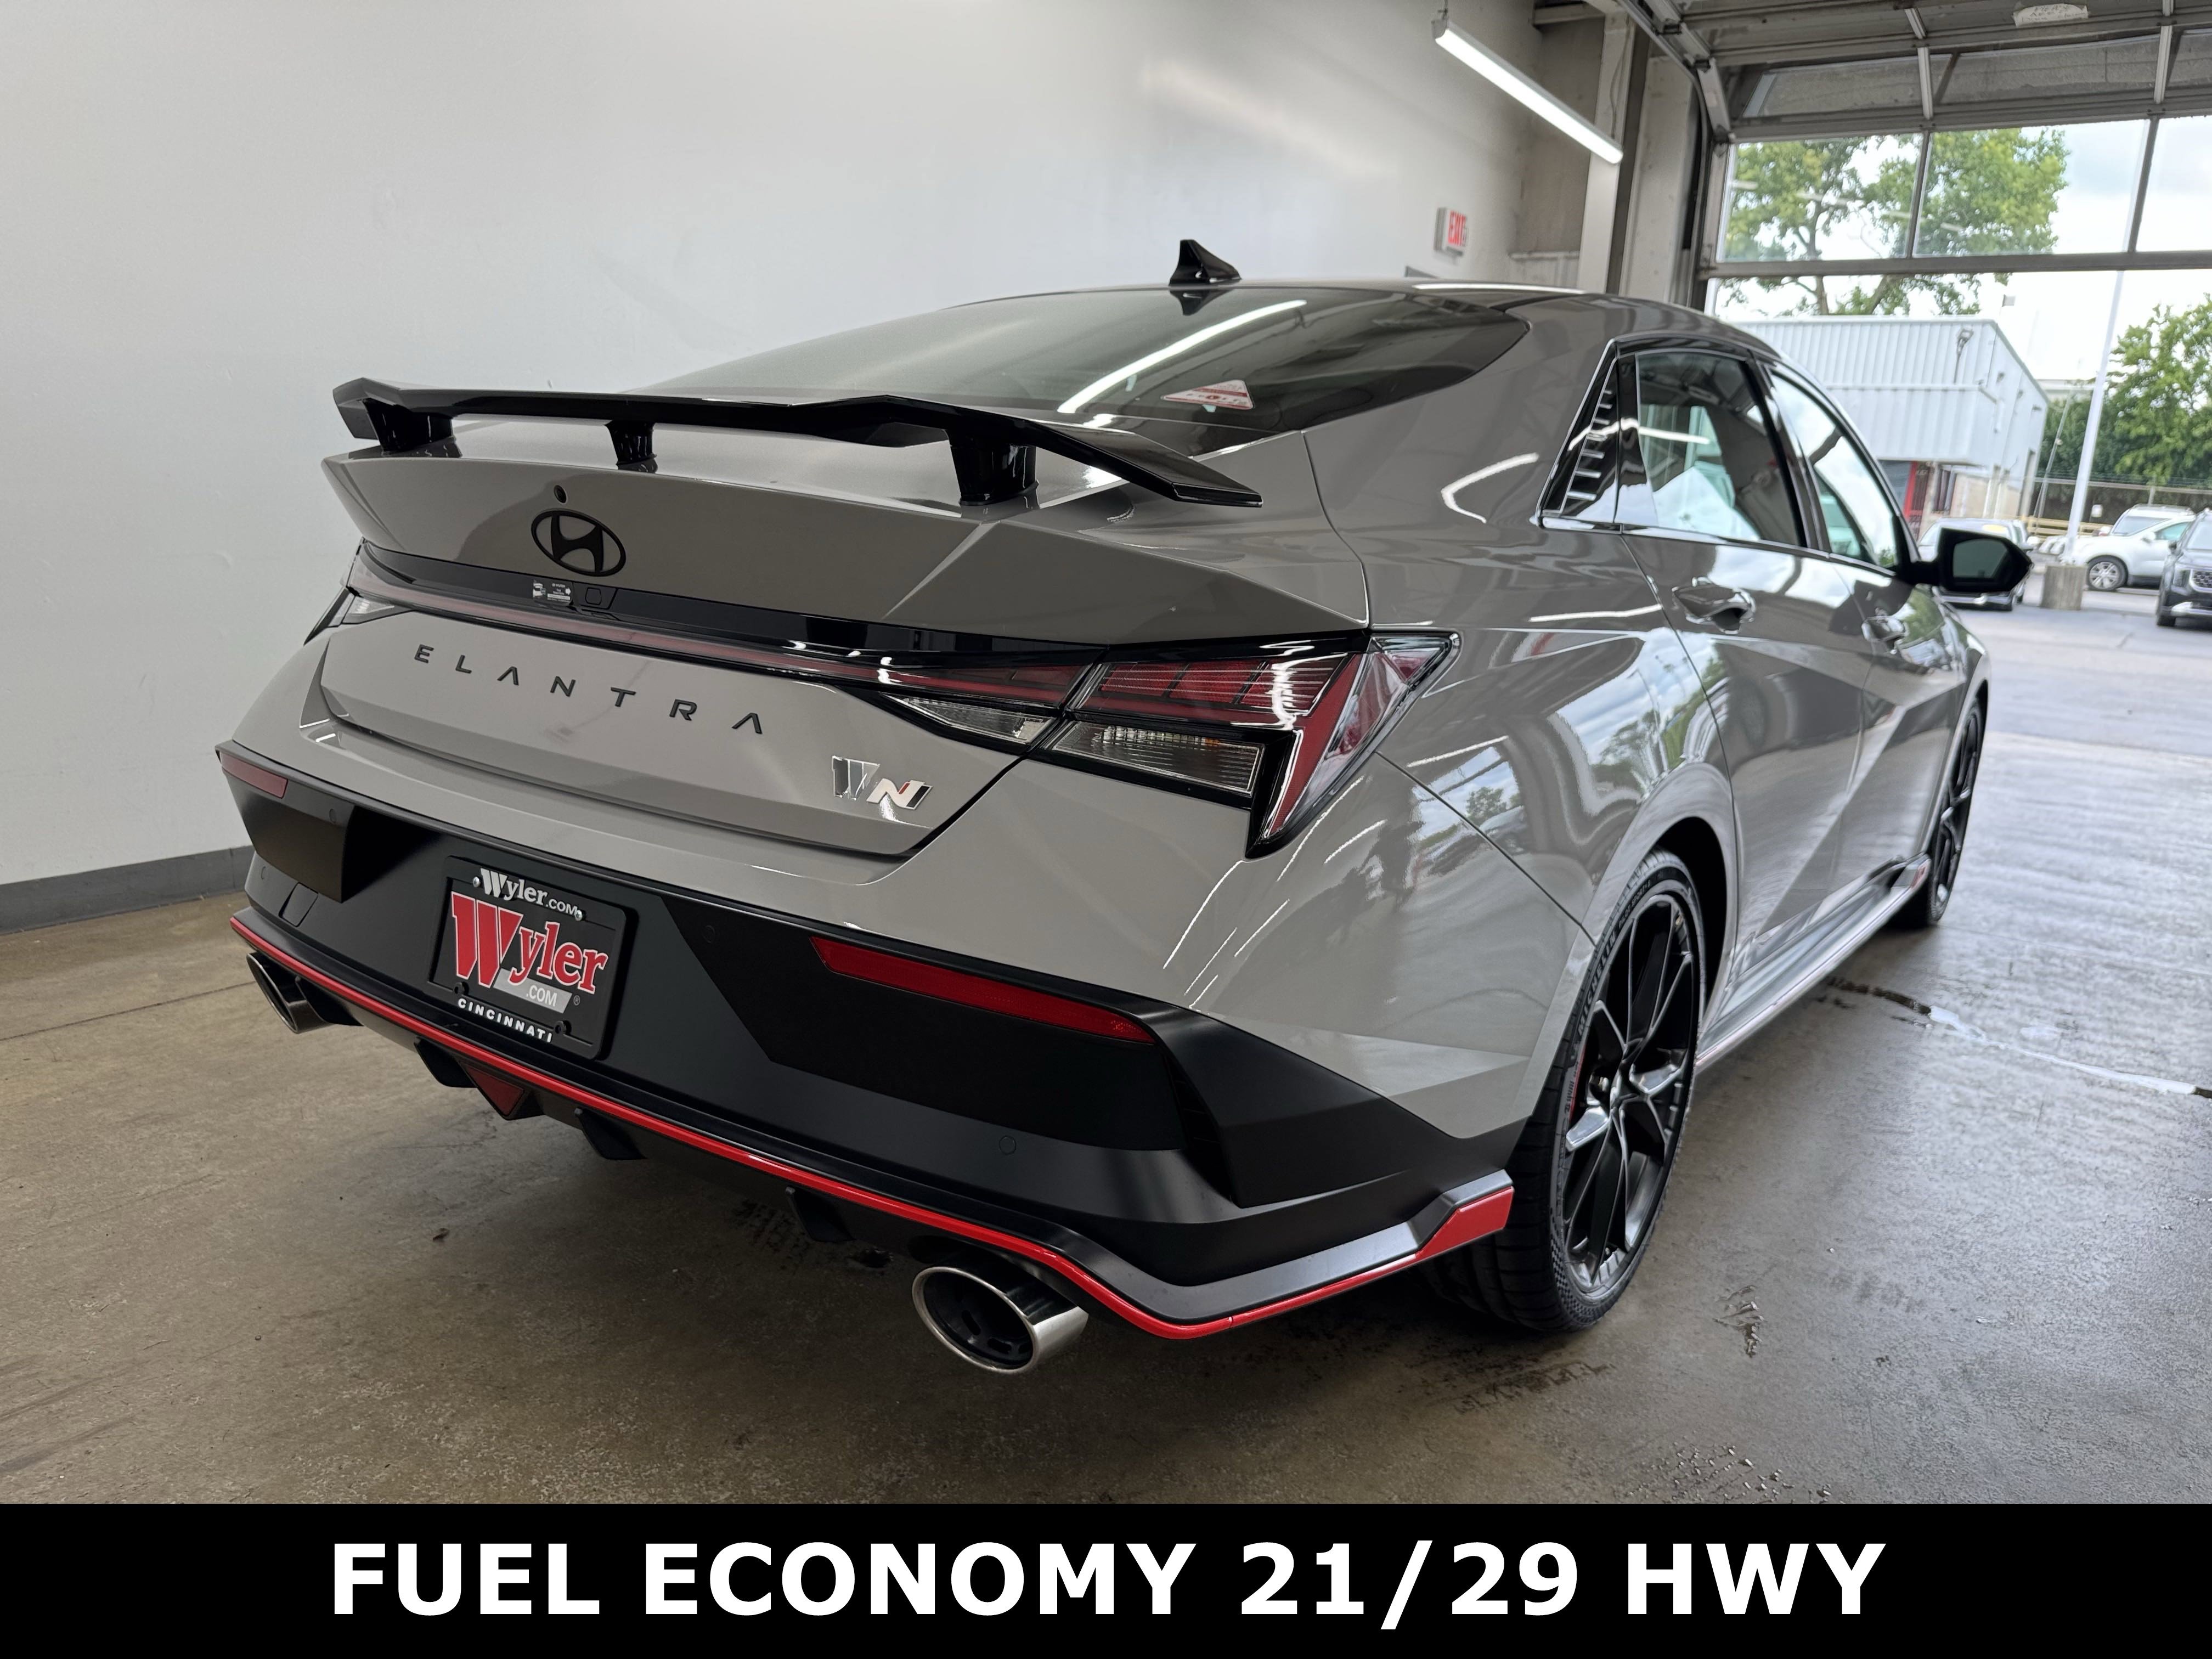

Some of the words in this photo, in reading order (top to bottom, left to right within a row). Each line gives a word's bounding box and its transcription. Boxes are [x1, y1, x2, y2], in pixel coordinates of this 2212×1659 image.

[414, 644, 763, 735] ELANTRA
[451, 891, 608, 994] Wyler
[1577, 928, 1617, 1037] MICHELIN
[458, 997, 552, 1043] CINCINNATI
